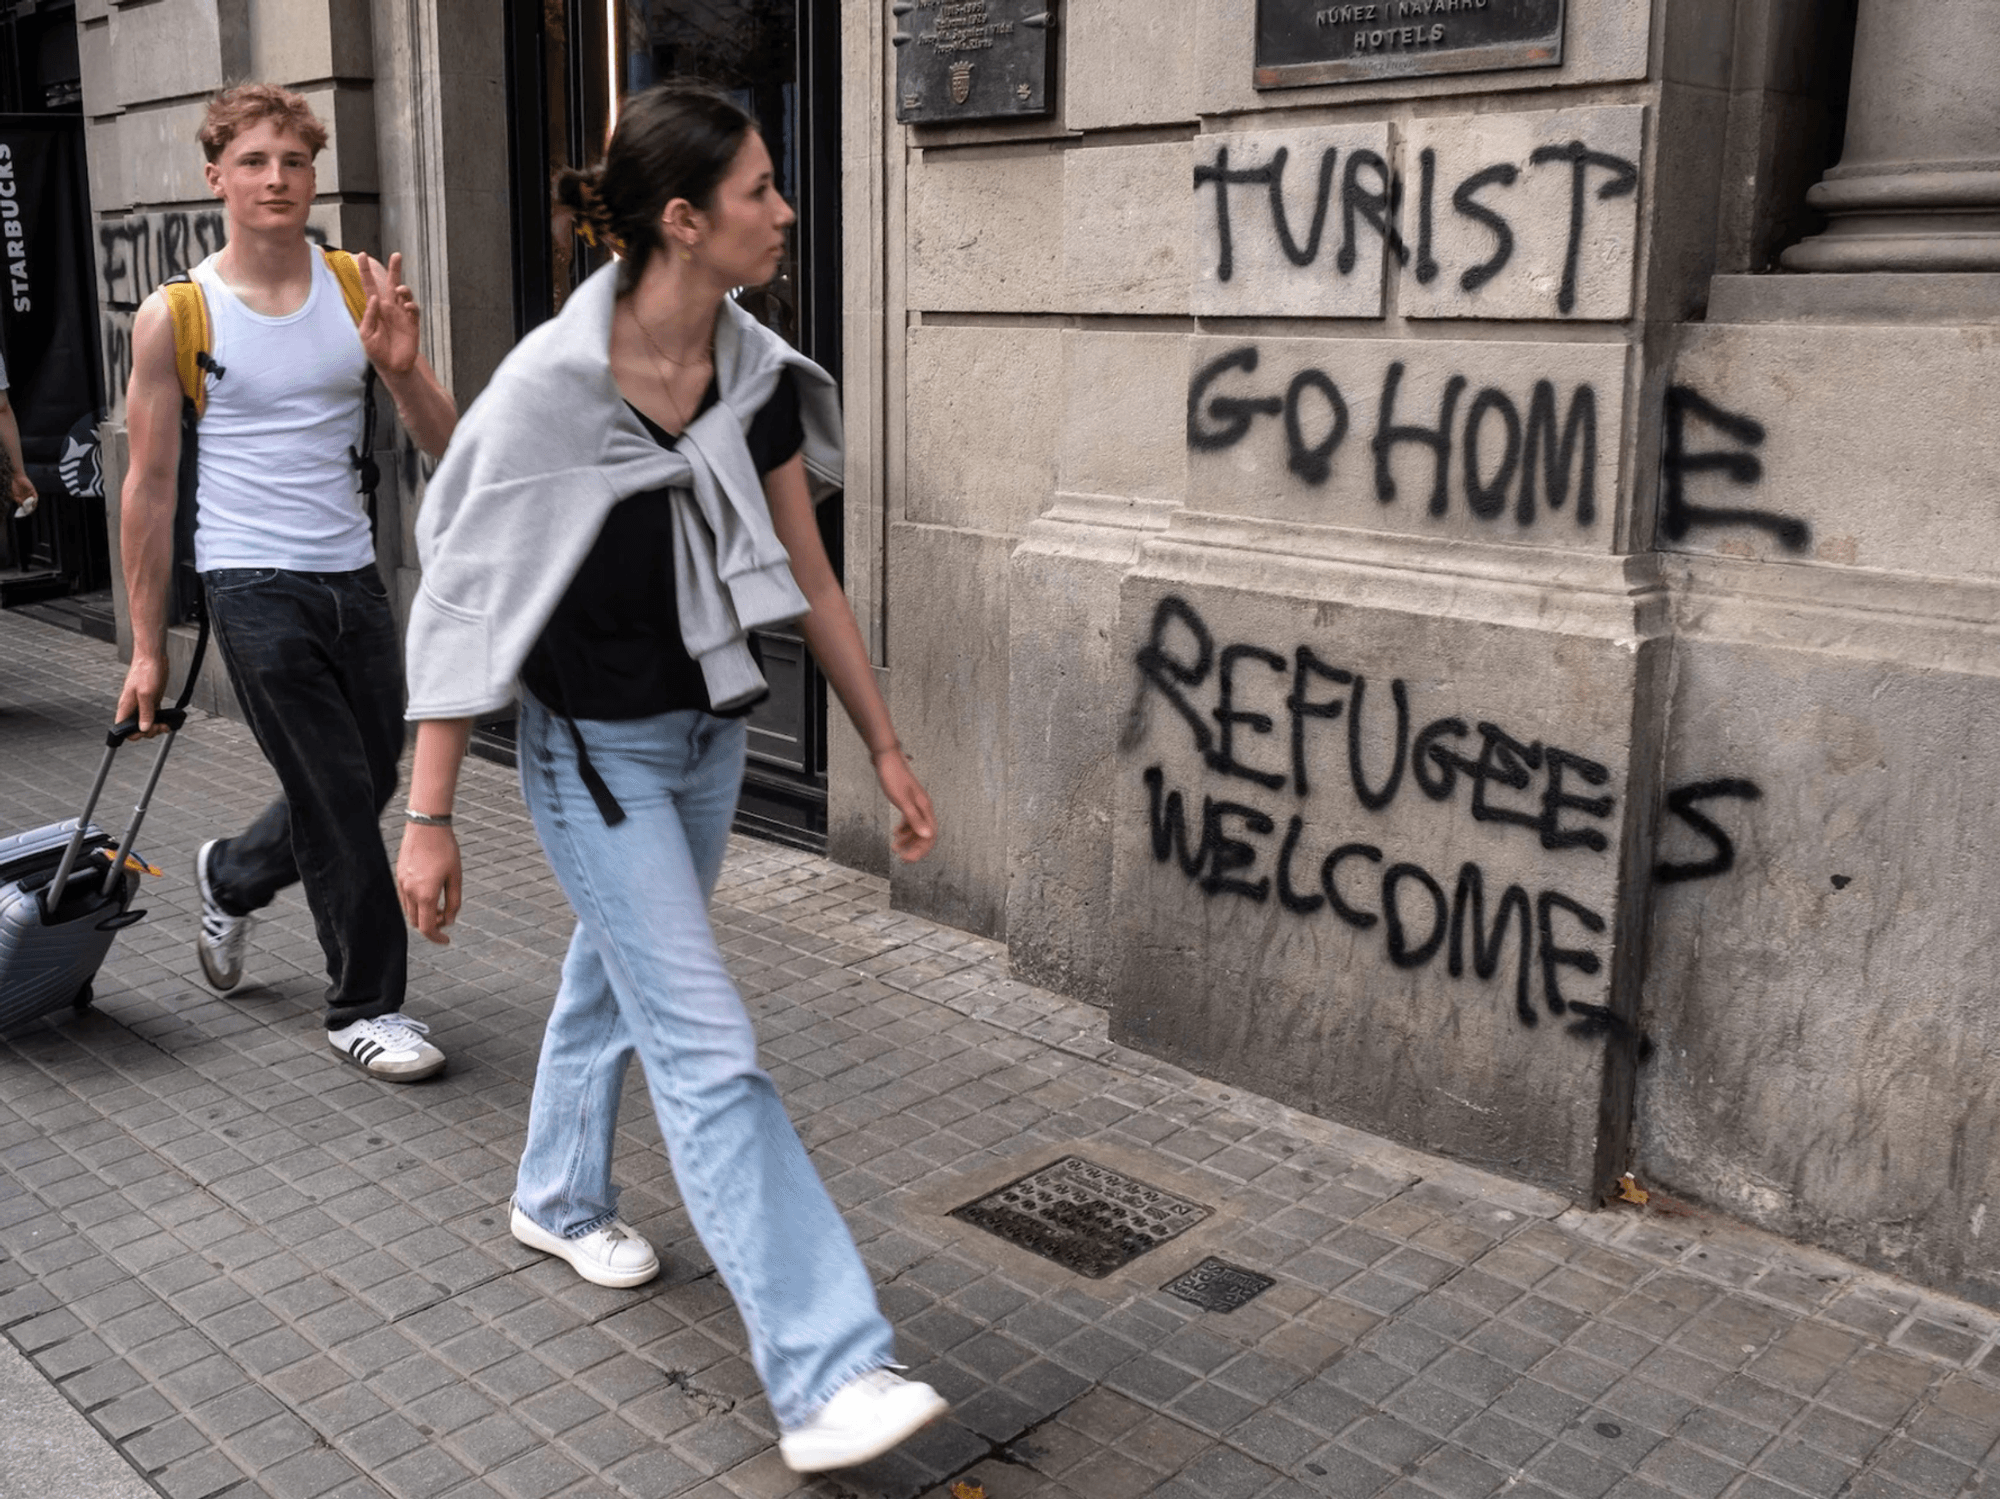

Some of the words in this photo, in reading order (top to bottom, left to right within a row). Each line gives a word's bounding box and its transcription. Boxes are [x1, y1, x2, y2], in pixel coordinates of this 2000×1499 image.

[1316, 4, 1376, 26] NÚÑEZ
[1354, 23, 1446, 49] HOTELS
[0, 144, 31, 312] STARBUCKS
[1193, 141, 1637, 314] TURIST
[1187, 346, 1347, 486] GO
[1372, 361, 1812, 550] HOME
[1122, 595, 1763, 886] REFUGEES
[1143, 766, 1652, 1060] WELCOME
